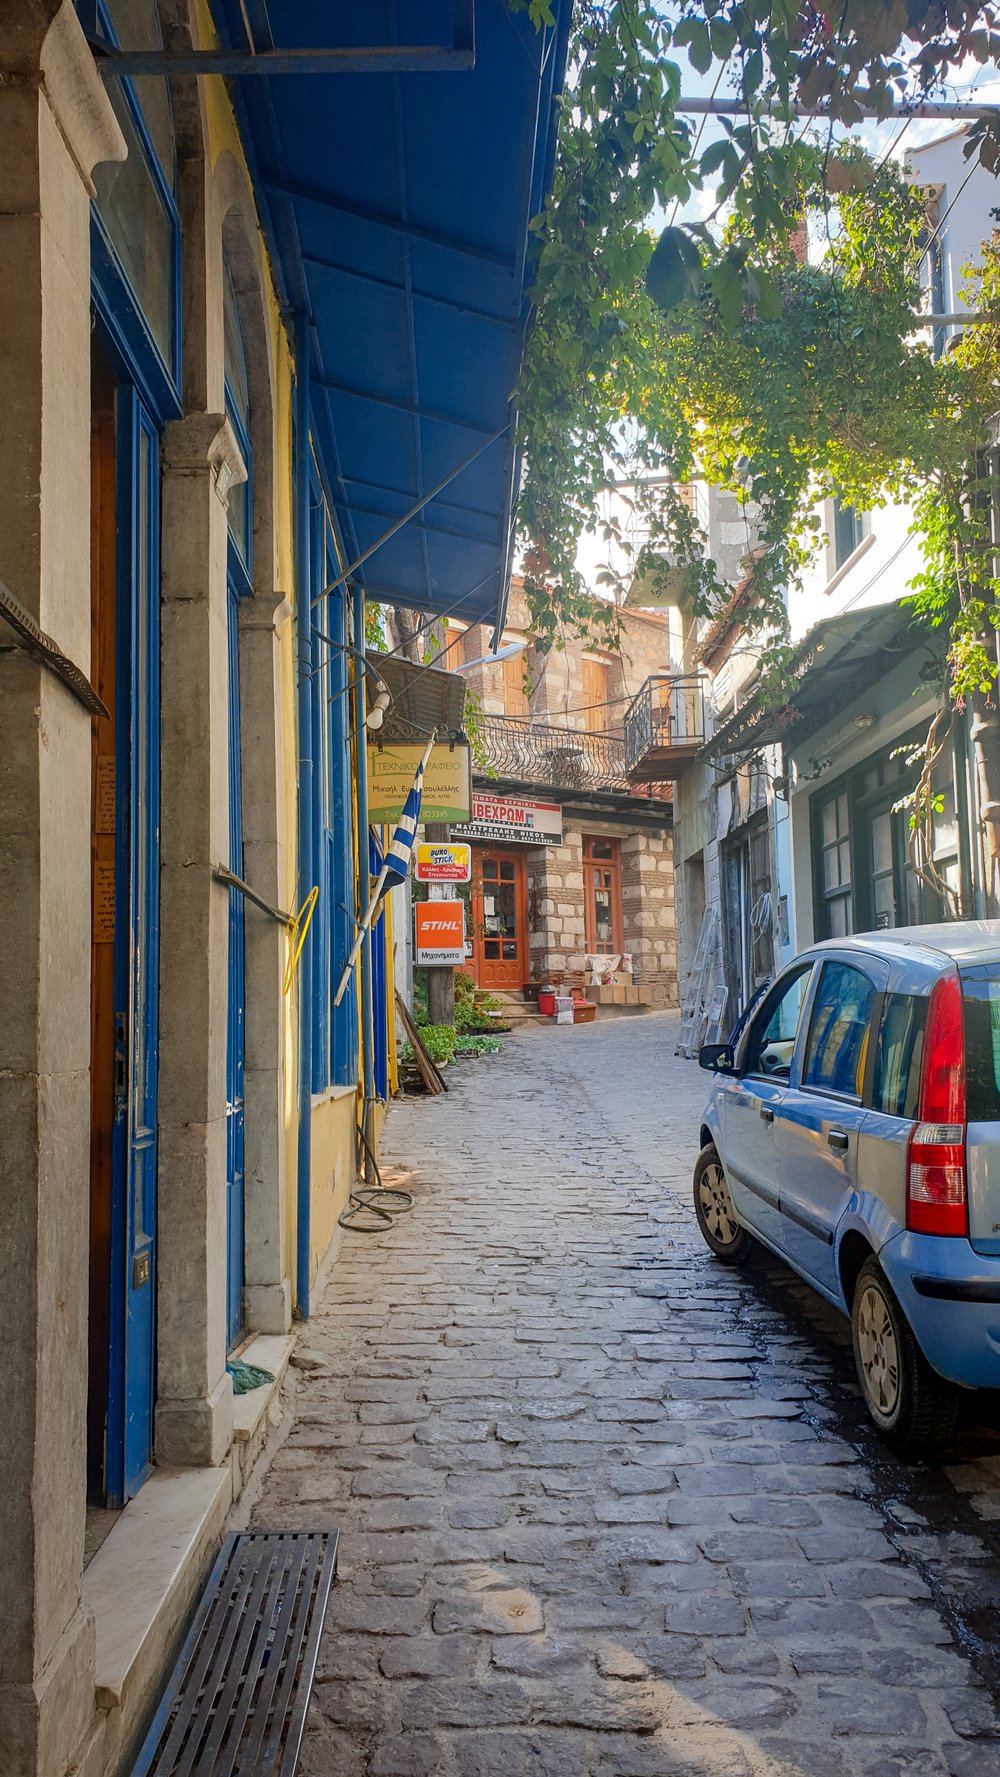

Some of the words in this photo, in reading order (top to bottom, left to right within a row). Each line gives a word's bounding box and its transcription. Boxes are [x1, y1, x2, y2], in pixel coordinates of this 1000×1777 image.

[376, 762, 419, 771] ΤΕΧΝΙΚΟ
[426, 761, 461, 771] ΡΑΦΕΙΟ
[372, 785, 398, 794] Μιχαήλ
[422, 784, 459, 794] σουλέλλης
[474, 795, 498, 803] ΩΜΑΤΑ
[504, 799, 537, 808] ΒΕΡΝΙΚΙΑ
[473, 803, 525, 823] ΙΒΕΧΡΩΜ
[520, 831, 545, 839] ΝΙΚΟΣ
[430, 849, 448, 857] DURO
[434, 856, 453, 864] STICK
[420, 920, 461, 931] STIHL
[421, 951, 460, 960] Μηχανήματα
